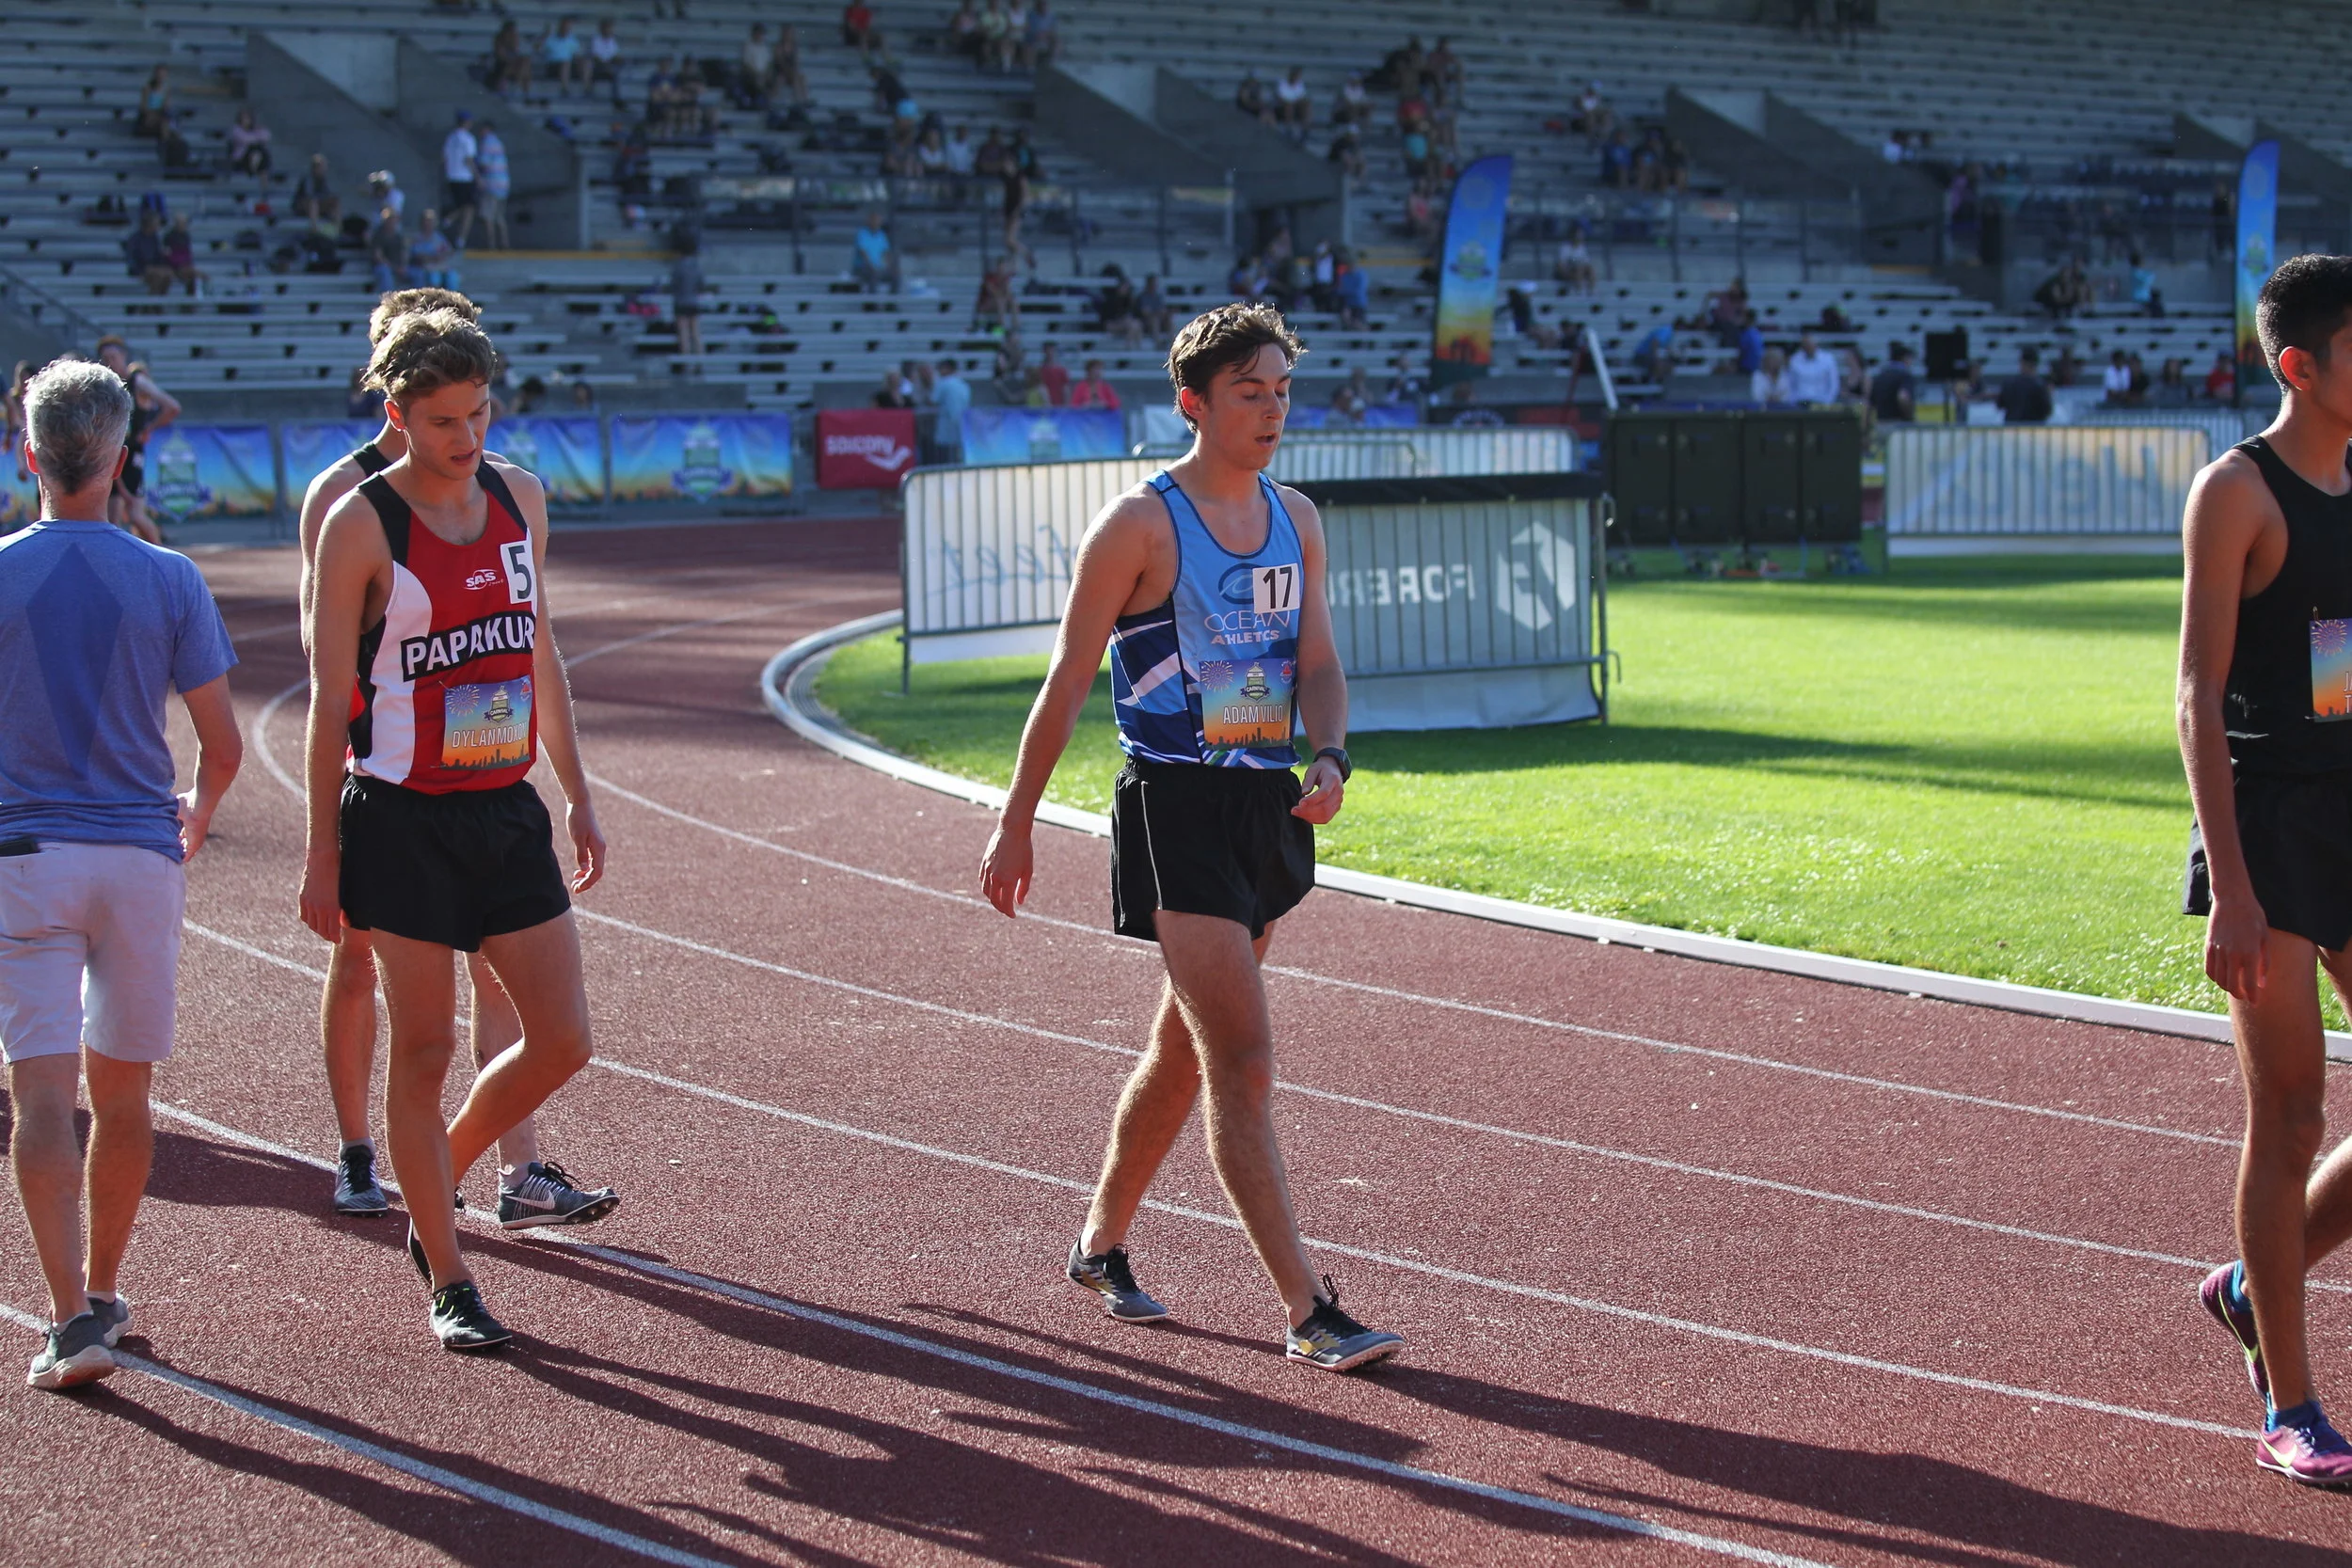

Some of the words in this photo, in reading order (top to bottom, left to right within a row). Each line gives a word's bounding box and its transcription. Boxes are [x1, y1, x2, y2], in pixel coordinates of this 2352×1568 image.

[466, 571, 497, 589] SAS
[507, 545, 532, 600] 5
[1263, 566, 1293, 610] 17
[1204, 610, 1291, 632] OCEAN
